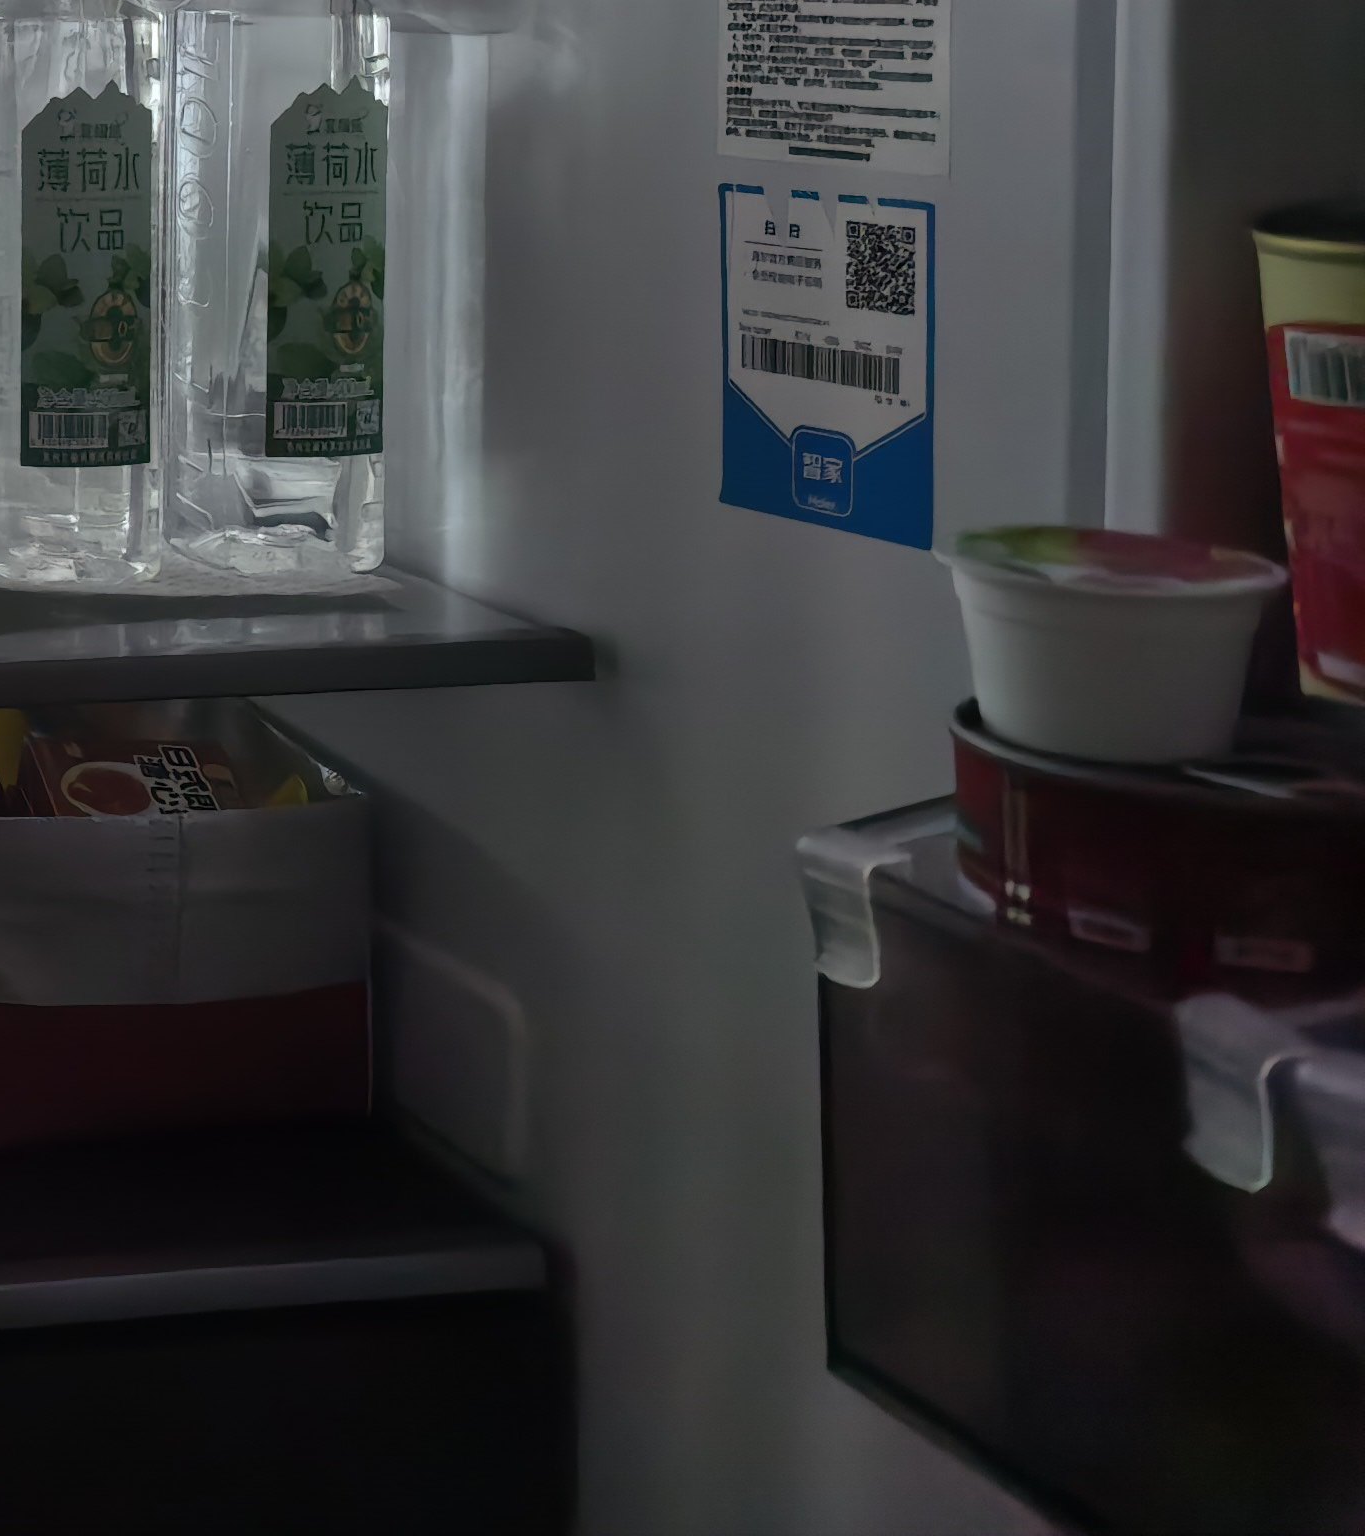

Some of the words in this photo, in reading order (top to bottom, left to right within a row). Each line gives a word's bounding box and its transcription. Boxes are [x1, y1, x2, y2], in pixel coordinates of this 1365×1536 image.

[36, 147, 139, 193] 薄荷水
[285, 141, 379, 186] 薄荷水
[56, 207, 125, 253] 饮品
[303, 199, 364, 245] 饮品
